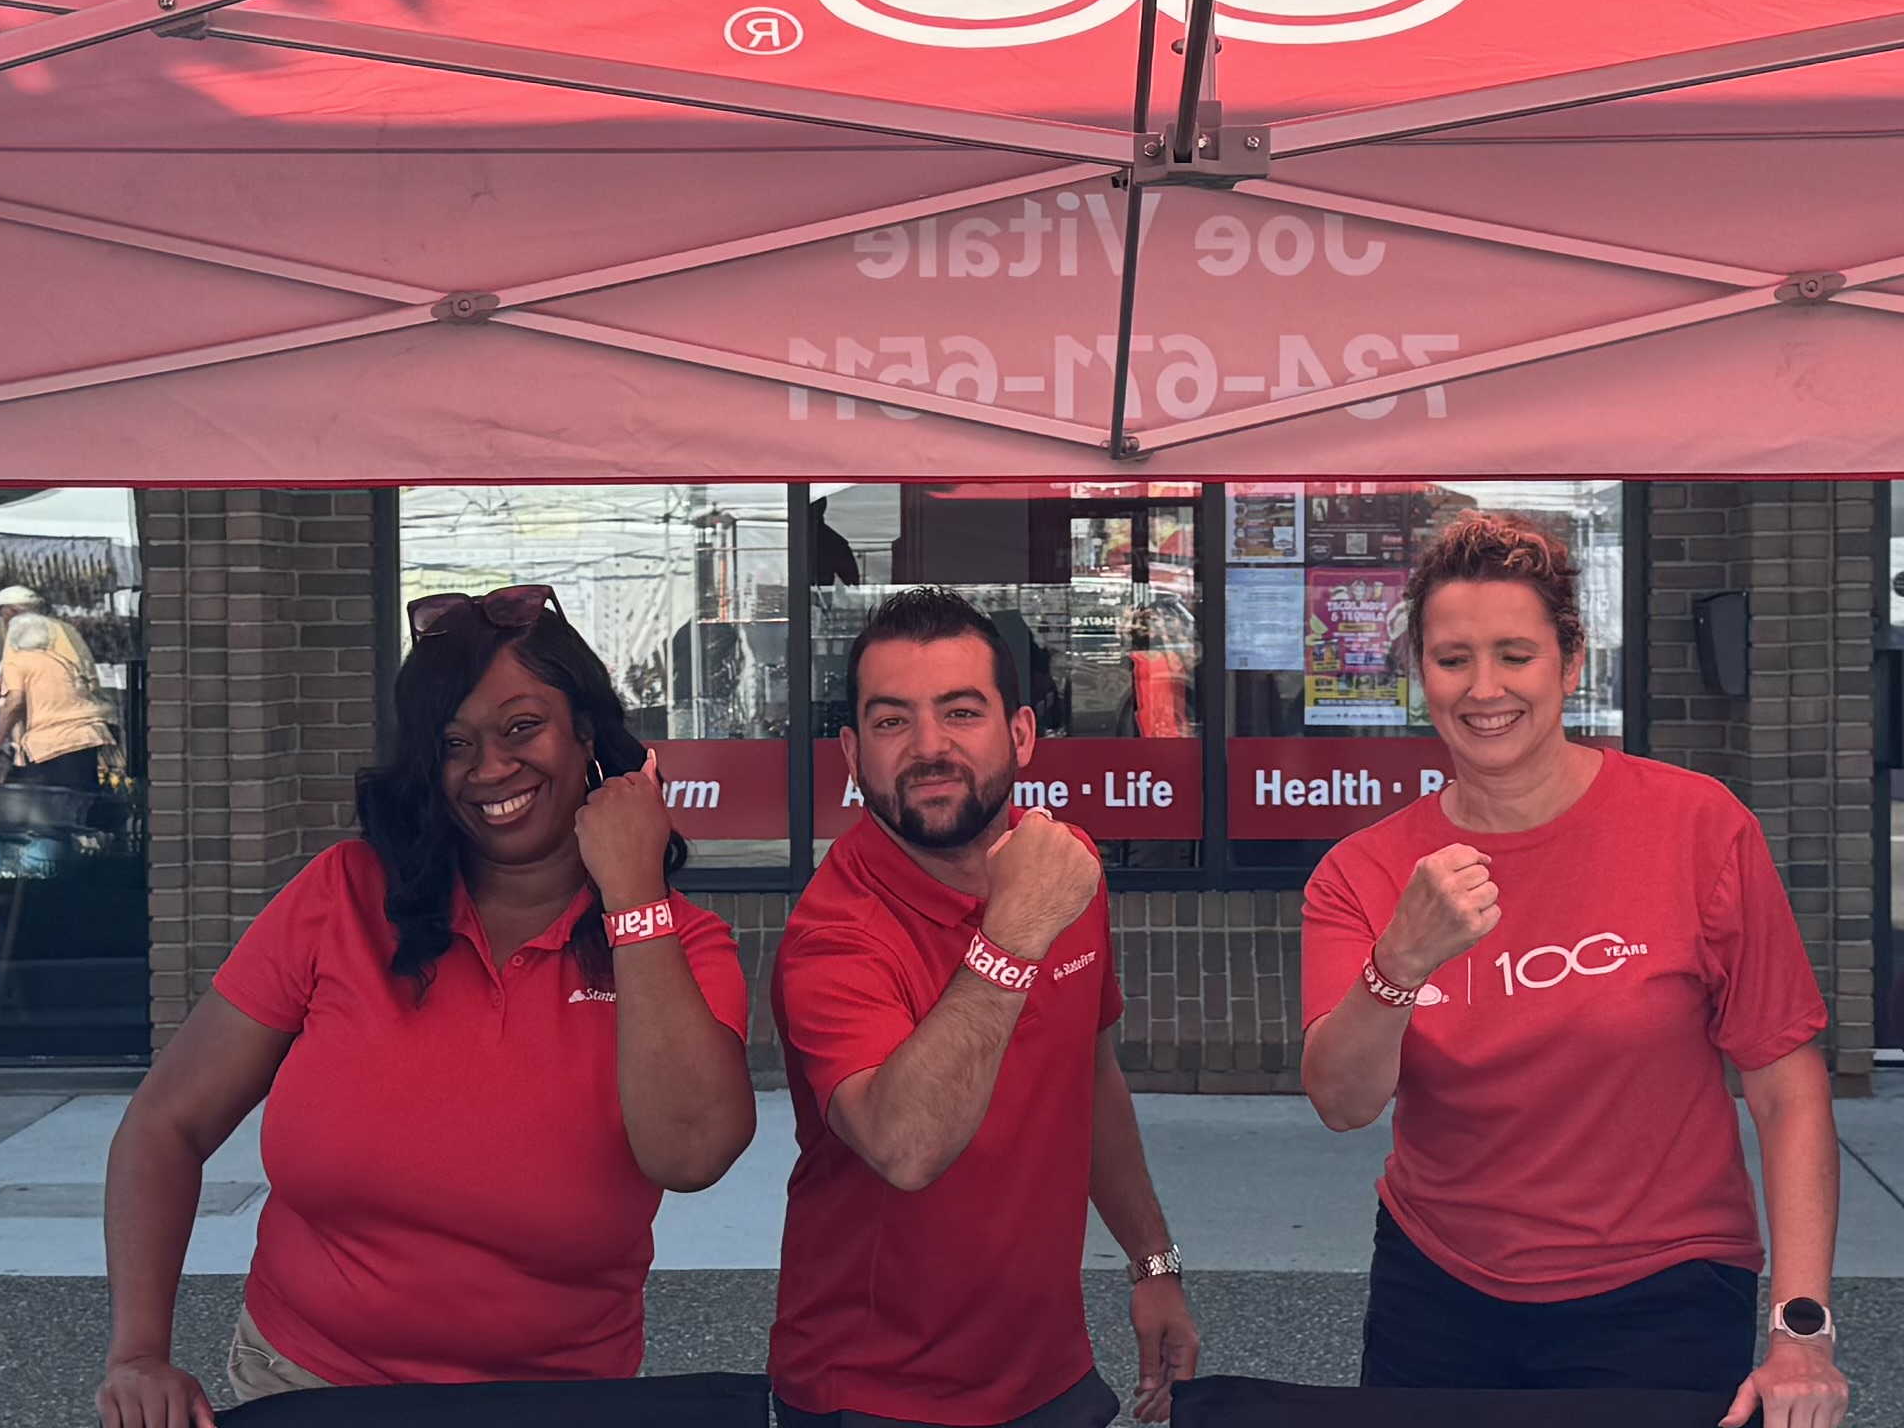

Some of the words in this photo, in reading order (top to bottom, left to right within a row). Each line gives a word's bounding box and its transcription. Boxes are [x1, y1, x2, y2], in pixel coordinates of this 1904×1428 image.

[662, 780, 720, 808] rm
[1013, 780, 1069, 809] me
[1104, 771, 1173, 809] Life
[1255, 769, 1381, 807] Health
[1494, 932, 1627, 996] 100
[1603, 943, 1648, 958] YEARS
